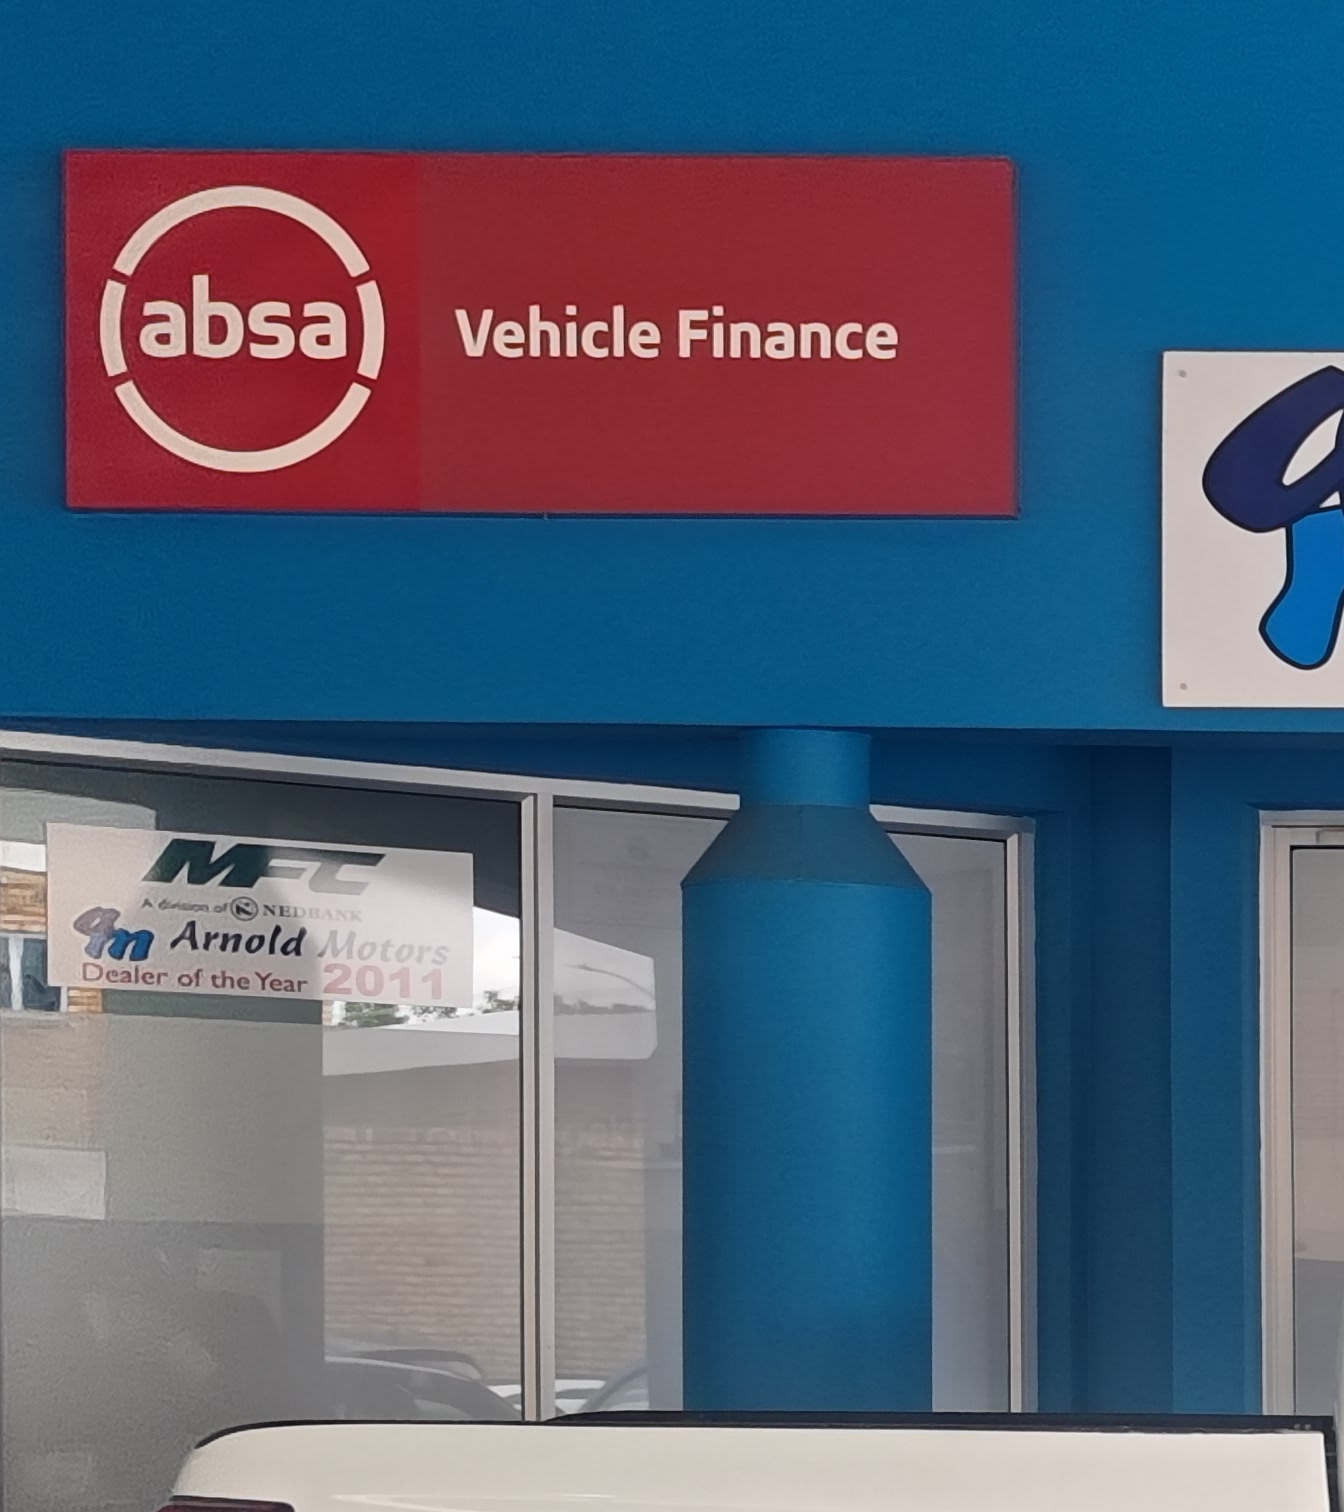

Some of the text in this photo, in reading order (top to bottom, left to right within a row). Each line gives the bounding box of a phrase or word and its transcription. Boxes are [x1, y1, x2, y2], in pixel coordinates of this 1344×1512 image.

[138, 274, 349, 360] absa
[455, 305, 898, 360] Vehicle Finance
[141, 838, 387, 897] MFC
[262, 903, 363, 923] NEDBANK
[169, 919, 451, 966] Arnold Motors
[81, 962, 444, 1001] Dealer of the Year 2011
